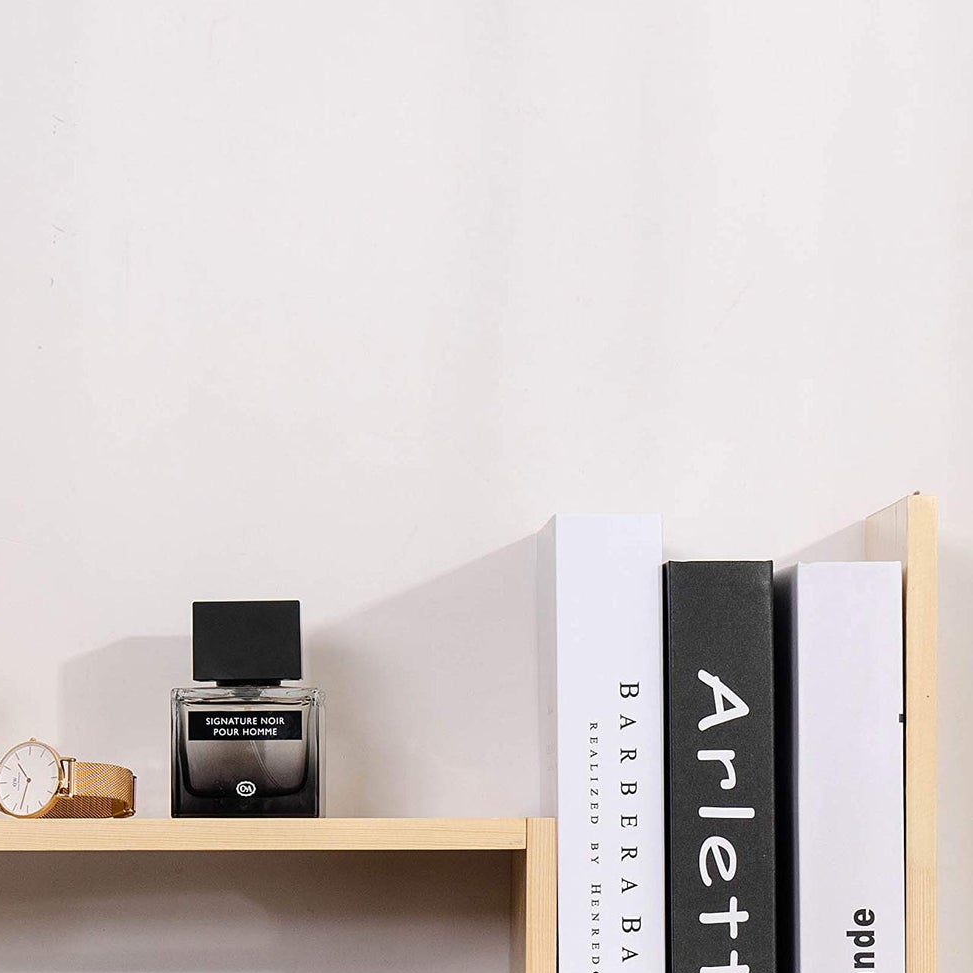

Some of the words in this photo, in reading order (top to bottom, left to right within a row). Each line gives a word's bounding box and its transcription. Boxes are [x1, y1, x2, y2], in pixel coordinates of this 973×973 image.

[205, 717, 258, 726] SIGNATURE
[260, 717, 285, 726] NOIR
[213, 728, 239, 737] POUR
[242, 728, 278, 736] HOMME
[589, 722, 600, 825] REALIZED
[619, 681, 640, 894] BARBERA
[590, 842, 600, 865] BY
